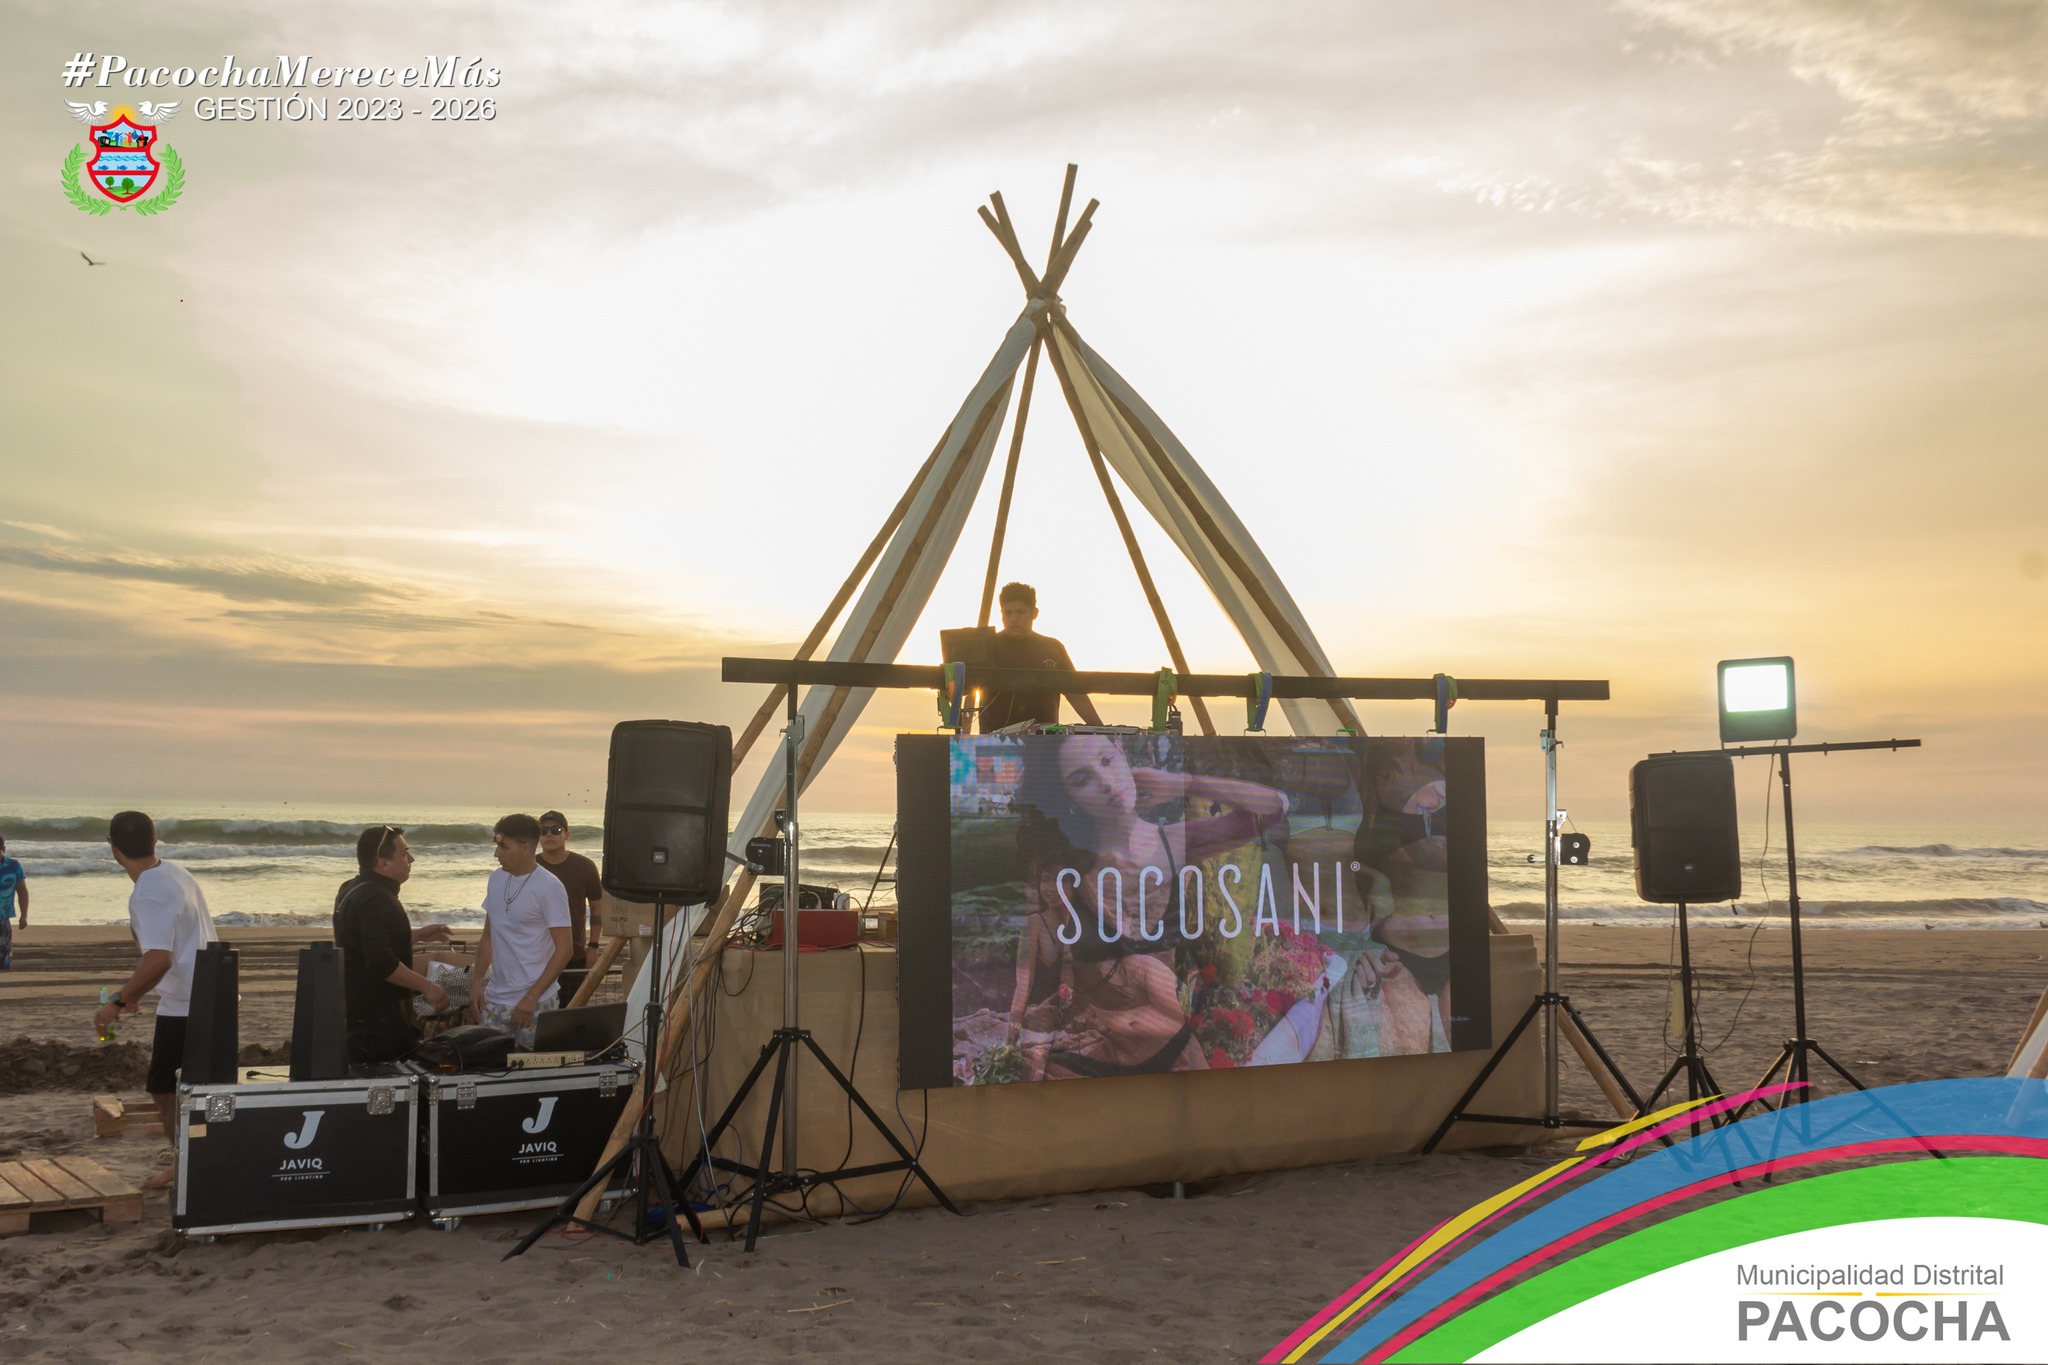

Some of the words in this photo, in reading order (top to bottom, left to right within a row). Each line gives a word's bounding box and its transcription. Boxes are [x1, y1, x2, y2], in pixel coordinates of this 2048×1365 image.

[521, 1096, 559, 1134] J
[283, 1110, 326, 1150] J
[518, 1141, 558, 1154] JAVIQ
[279, 1157, 323, 1171] JAVIQ
